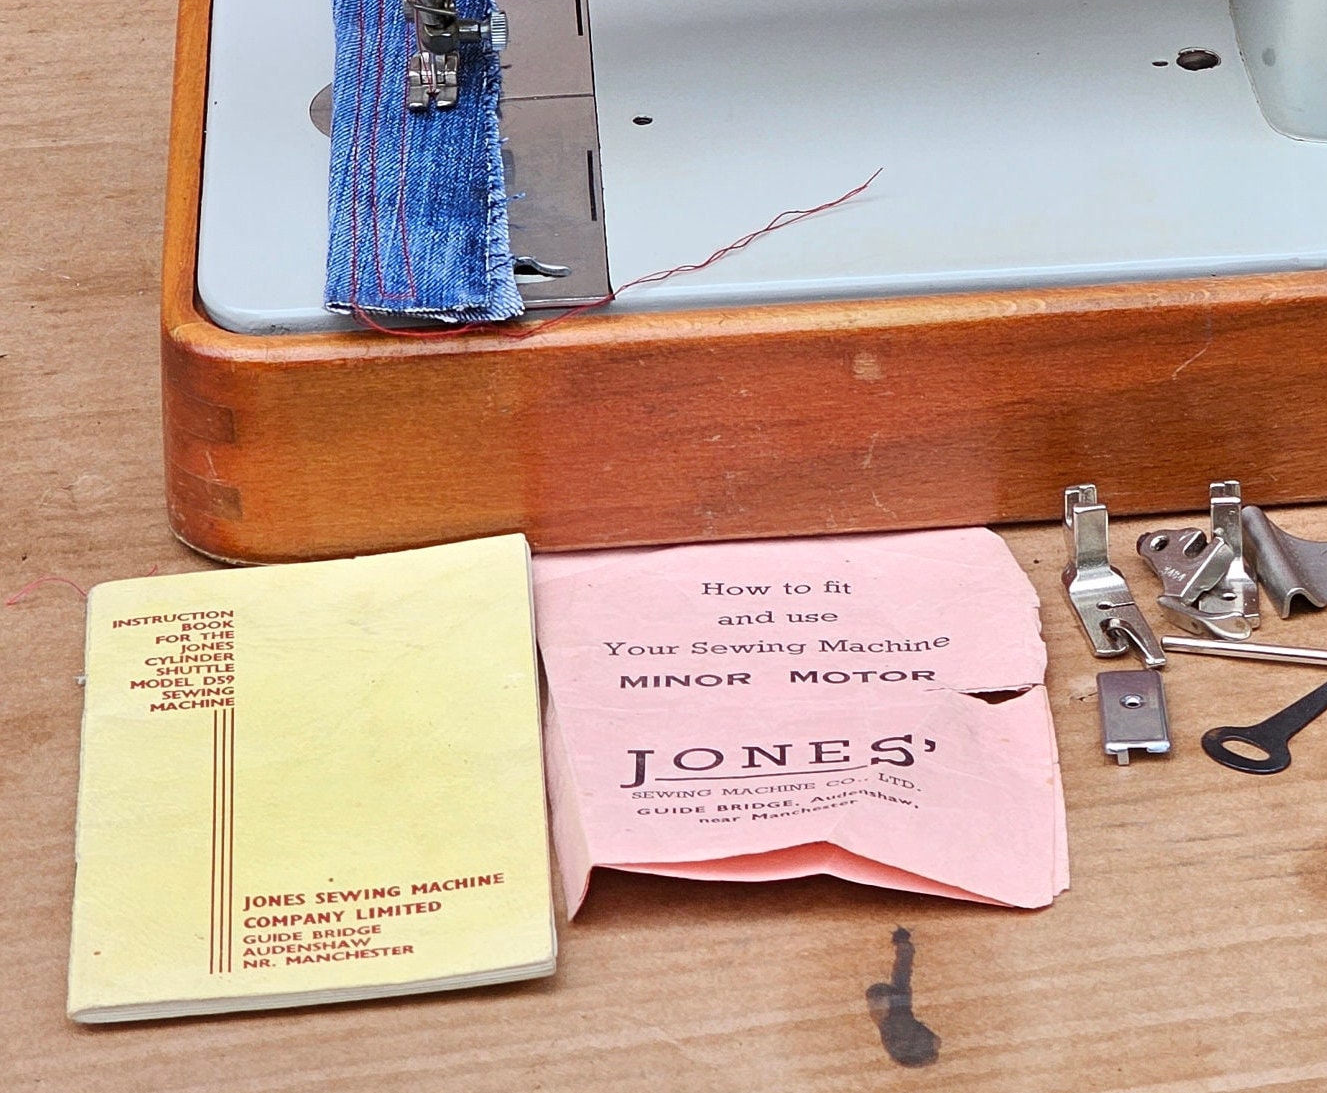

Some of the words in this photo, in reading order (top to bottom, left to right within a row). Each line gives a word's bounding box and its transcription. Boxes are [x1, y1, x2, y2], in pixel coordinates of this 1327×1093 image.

[701, 582, 772, 596] How
[783, 582, 811, 595] to
[823, 580, 852, 595] fit
[112, 610, 234, 629] INSTRUCTION
[181, 620, 234, 632] BOOK
[717, 611, 776, 626] and
[786, 611, 839, 624] use
[155, 634, 191, 644] FOR
[200, 631, 234, 641] THE
[603, 642, 680, 656] Your
[691, 639, 807, 655] Sewing
[818, 636, 951, 653] Machine
[181, 642, 234, 654] JONES
[144, 652, 235, 666] CYLINDER
[156, 663, 235, 676] SHUTTLE
[130, 677, 194, 689] MODEL
[203, 675, 235, 686] D59
[619, 672, 752, 688] MINOR
[789, 670, 937, 684] MOTOR
[162, 687, 235, 700] SEWING
[150, 698, 235, 712] MACHINE
[631, 790, 712, 800] SEWING
[721, 783, 816, 797] MACHINE
[877, 772, 922, 791] LTD.
[636, 806, 706, 815] GUIDE
[810, 789, 920, 809] Audenshaw,
[698, 816, 741, 824] near
[751, 799, 859, 821] Manchester
[243, 893, 306, 912] JONES
[315, 886, 401, 904] SEWING
[411, 873, 505, 895] MACHINE
[243, 911, 345, 929] COMPANY
[356, 901, 442, 920] LIMITED
[243, 932, 303, 945] GUIDE
[312, 925, 382, 940] BRIDGE
[242, 938, 371, 957] AUDENSHAW
[243, 958, 277, 970] NR.
[285, 945, 414, 966] MANCHESTER
